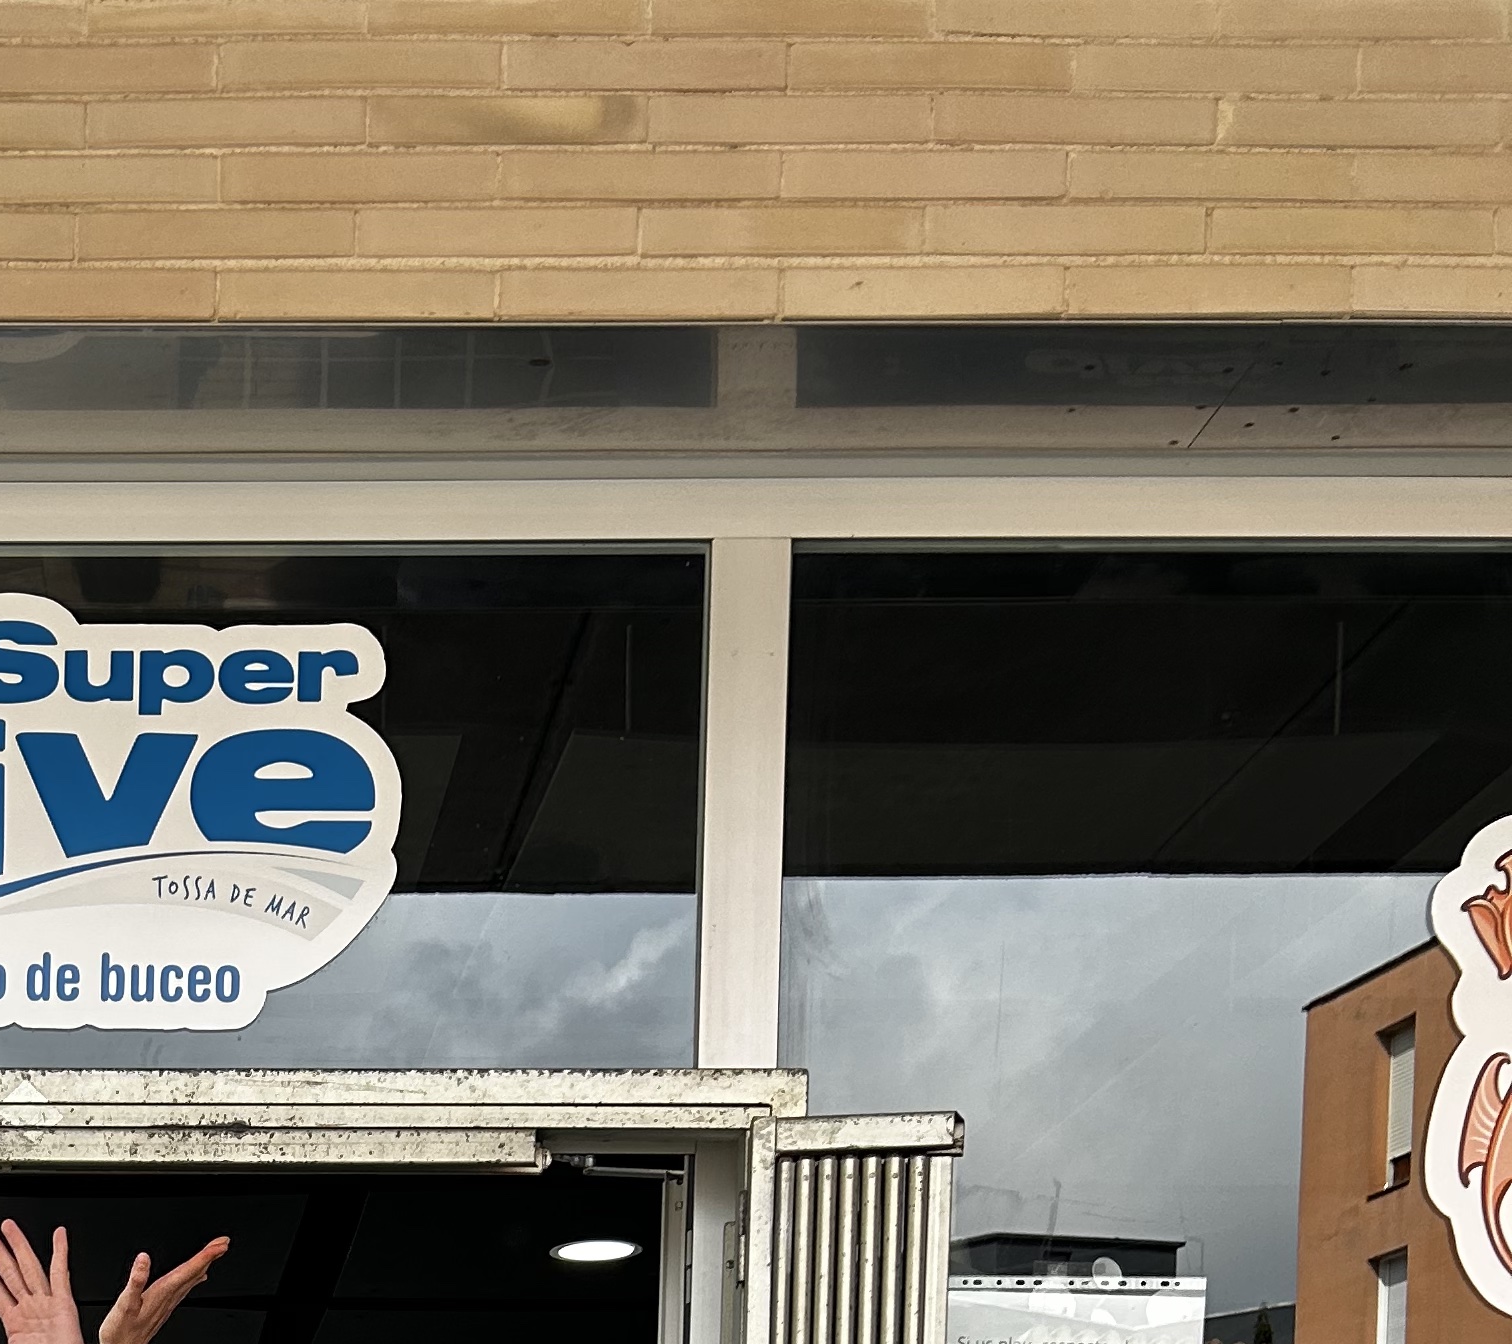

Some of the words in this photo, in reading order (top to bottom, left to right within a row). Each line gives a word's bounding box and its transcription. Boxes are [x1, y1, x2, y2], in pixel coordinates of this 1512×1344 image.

[231, 884, 258, 907] DE
[265, 892, 311, 929] MAR
[25, 953, 80, 1002] de
[100, 953, 241, 1002] buceo
